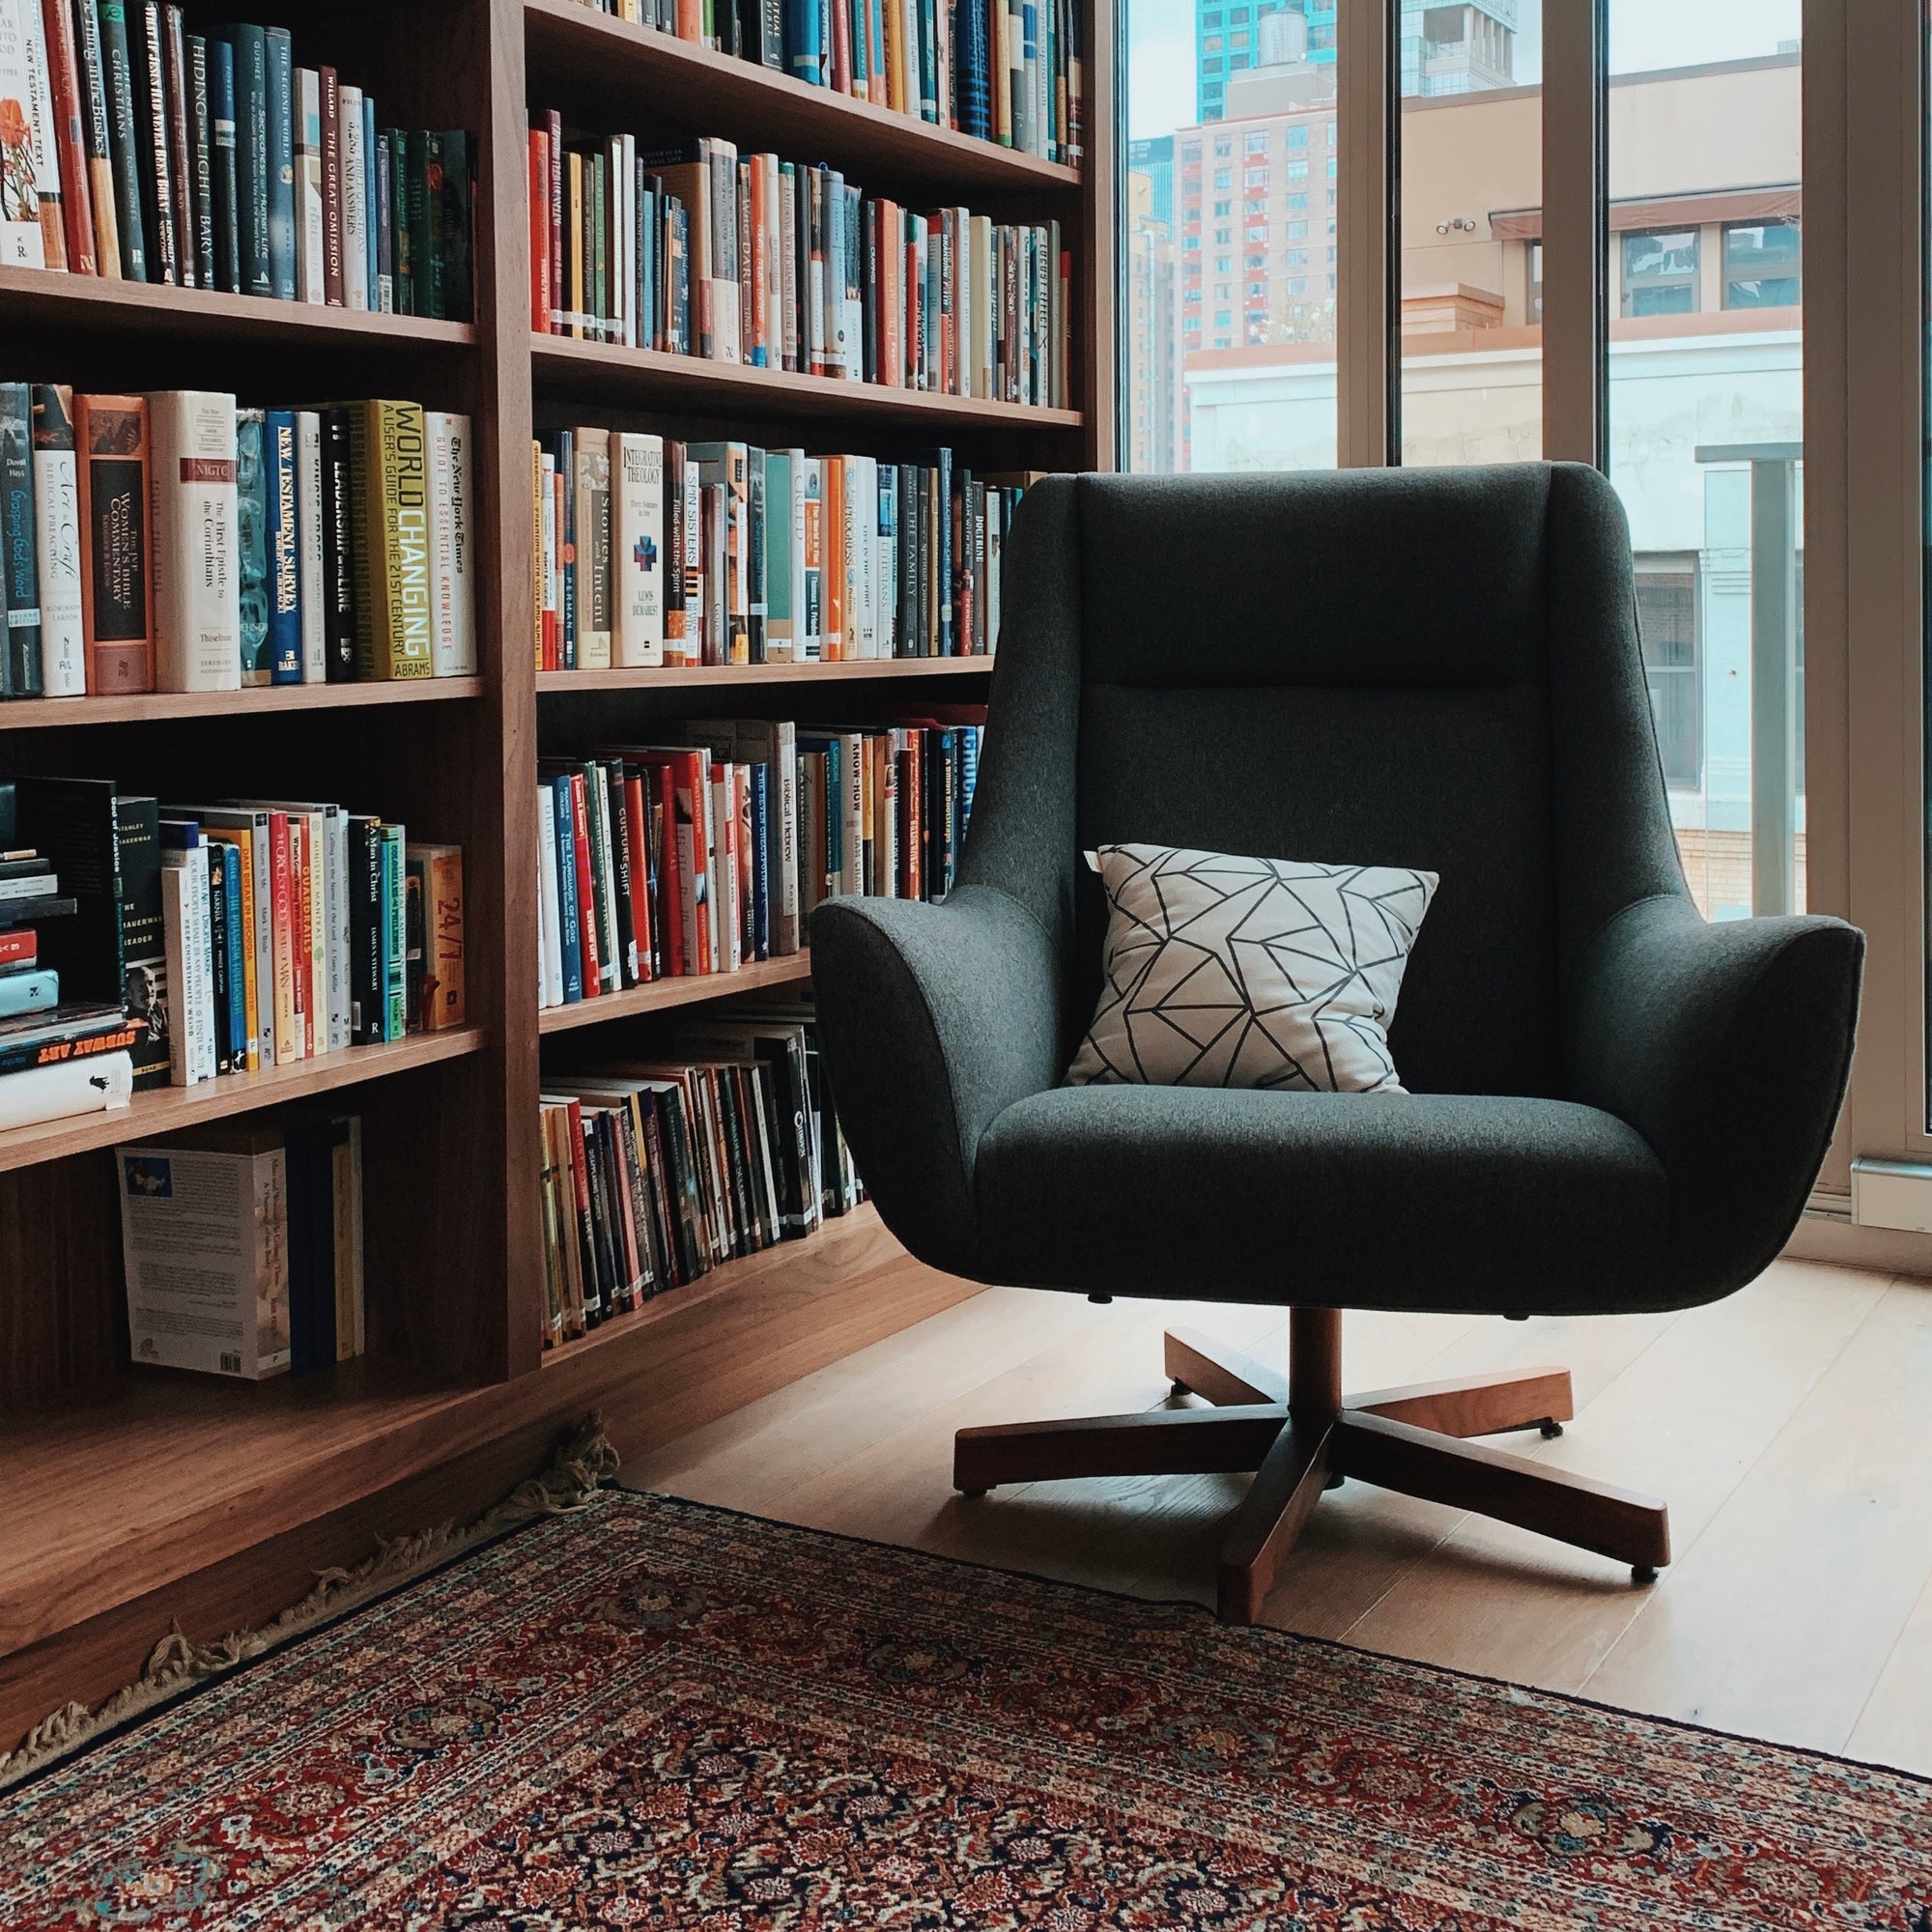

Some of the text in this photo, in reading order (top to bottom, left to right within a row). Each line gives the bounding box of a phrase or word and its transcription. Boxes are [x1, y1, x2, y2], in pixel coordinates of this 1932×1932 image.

[145, 7, 157, 39] WHAT
[84, 19, 105, 155] Thing in the Bushes
[112, 49, 128, 139] CHRISTIANS
[148, 53, 160, 87] JESUS
[25, 40, 44, 166] NEW TESTAMENT TEXT
[123, 65, 134, 129] THE NEW
[150, 88, 163, 112] HAD
[152, 113, 165, 148] NEVER
[193, 45, 210, 202] HIDING LIGHT
[258, 109, 267, 175] Sacredness
[328, 162, 337, 208] GREAT
[346, 184, 355, 235] ANSWERS
[166, 219, 175, 265] KENNEDY
[200, 214, 213, 260] BARY
[329, 211, 339, 277] OMISSION
[743, 242, 752, 289] DARE
[1039, 292, 1048, 328] EFFECT
[196, 465, 228, 476] NIGTC
[623, 446, 662, 468] INTEGRATIVE
[627, 466, 661, 484] THEOLOGY
[45, 463, 58, 580] BIBLICAL PREACHING
[280, 427, 297, 612] NEW TESTAMENT SURVEY
[384, 405, 405, 655] A USER'S GUIDE FOR THE 21ST CENTURY
[451, 437, 465, 574] The New York Times
[601, 497, 610, 563] Stories
[688, 475, 696, 563] SPIN SISTERS
[795, 475, 804, 540] CREED
[7, 490, 32, 597] Grasping Word
[111, 498, 122, 603] COMMENTARY
[204, 519, 214, 586] Corinthians
[216, 523, 225, 546] First
[334, 462, 351, 612] LEADERSHIP LINE
[437, 437, 452, 650] GUIDE TO ESSENTIAL KNOWLEDGE
[672, 499, 681, 593] Filled with the Spirit
[844, 506, 853, 566] PROGRESS
[976, 515, 984, 562] DOCTRINE
[123, 568, 131, 610] BIBLE
[215, 550, 227, 586] Epistle
[594, 565, 605, 624] Intent
[638, 590, 654, 602] LEWIS
[394, 663, 430, 677] ABRAMS
[783, 779, 793, 862] Biblical Hebrew
[371, 862, 378, 870] in
[371, 872, 380, 902] Christ
[244, 905, 252, 915] IN
[302, 867, 312, 953] GUARDRAILS
[569, 905, 575, 917] OF
[38, 1042, 71, 1064] ART
[73, 1030, 136, 1056] SUBWAY
